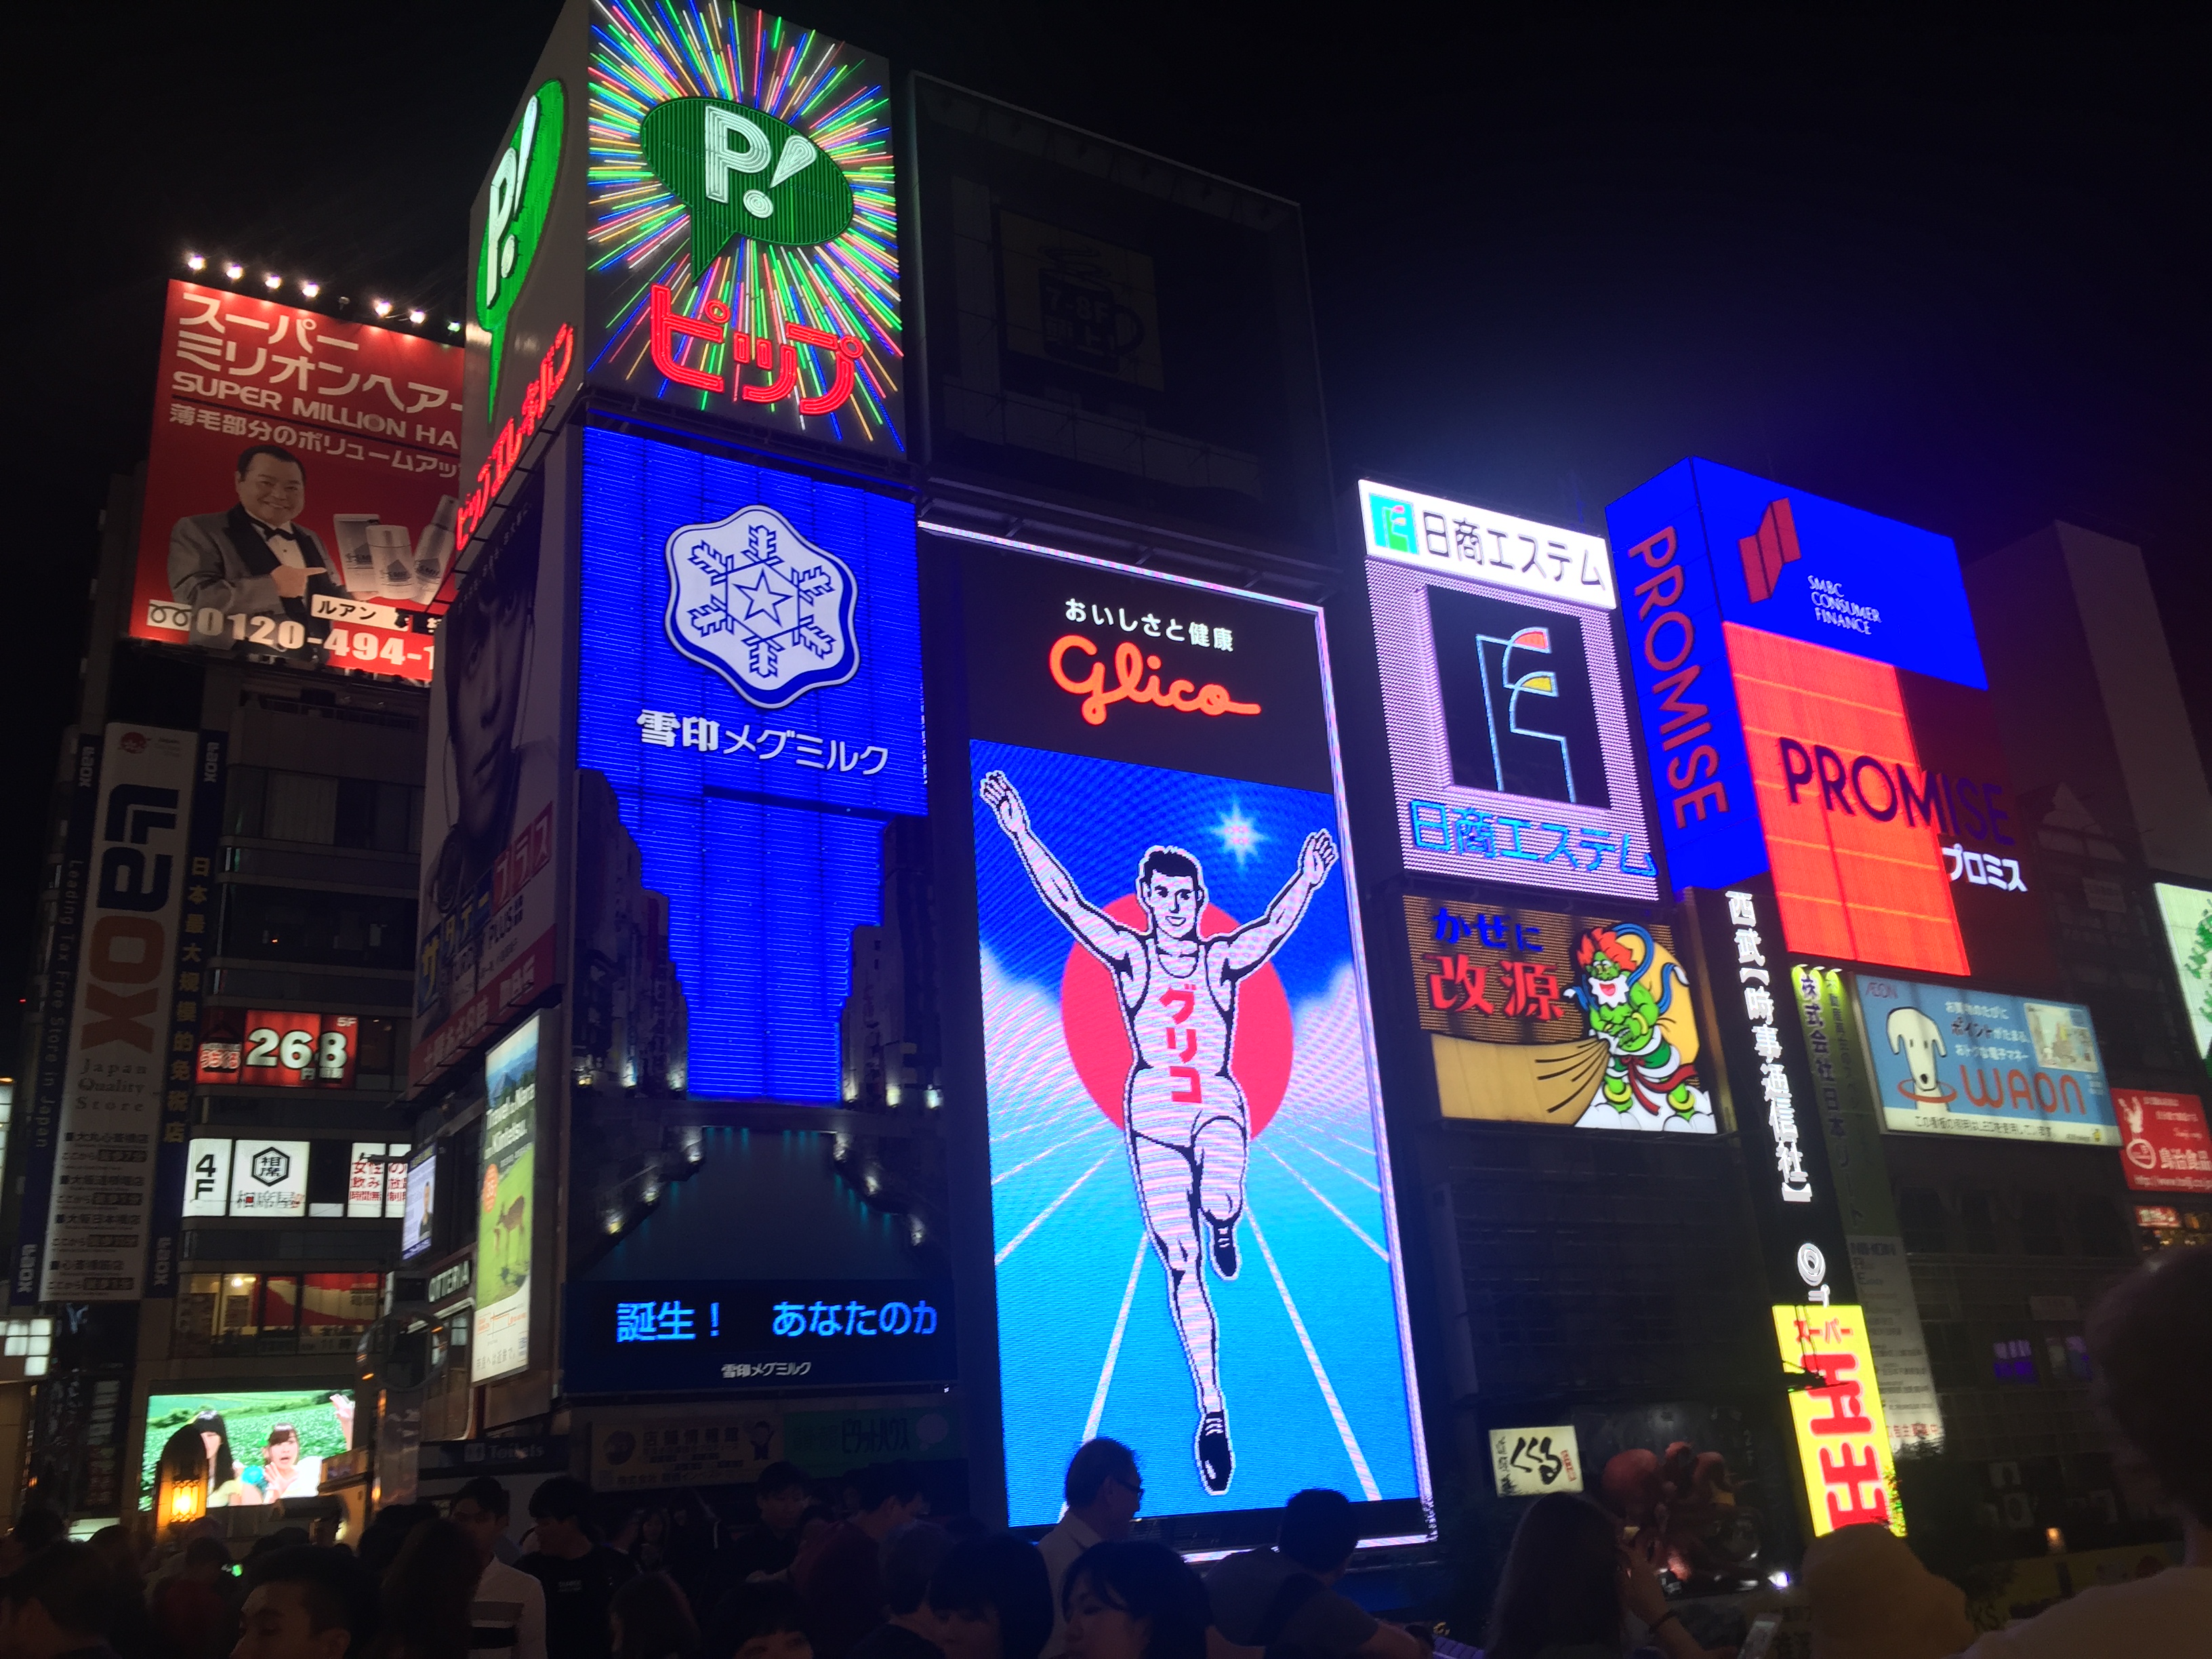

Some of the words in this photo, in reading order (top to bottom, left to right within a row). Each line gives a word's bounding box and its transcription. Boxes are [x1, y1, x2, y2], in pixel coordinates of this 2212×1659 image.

[704, 105, 817, 219] P!
[179, 292, 360, 352] スーパー
[649, 282, 865, 416] ピップ
[172, 371, 281, 411] SUPER
[292, 396, 407, 438] MILLION
[169, 403, 462, 478] 薄毛部分のボリュームアッ
[1422, 510, 1607, 592] 日商エステム
[316, 600, 377, 620] ルアン
[1807, 575, 1845, 599] SMBC
[1810, 592, 1883, 623] CONSUMER
[1064, 596, 1235, 653] おいしさと健康
[1814, 607, 1872, 635] FINANCE
[1628, 525, 1729, 830] PROMISE
[636, 708, 889, 776] 雪印メグミルク
[1778, 736, 2018, 847] PROMISE
[1408, 799, 1660, 878] 日商エステム
[1940, 842, 2028, 893] プロミス
[1433, 907, 1544, 954] かぜに
[1423, 953, 1565, 1021] 改源
[80, 1058, 148, 1078] Japan
[245, 1028, 348, 1069] 268
[1158, 983, 1203, 1103] グリコ
[75, 1097, 144, 1112] Store
[78, 1078, 146, 1093] Quality
[1959, 1064, 2087, 1115] WAON
[615, 1300, 720, 1343] 誕生！
[1793, 1317, 1855, 1345] スーパー
[720, 1361, 812, 1379] 雪印メグミルク
[1509, 1436, 1563, 1486] くくる
